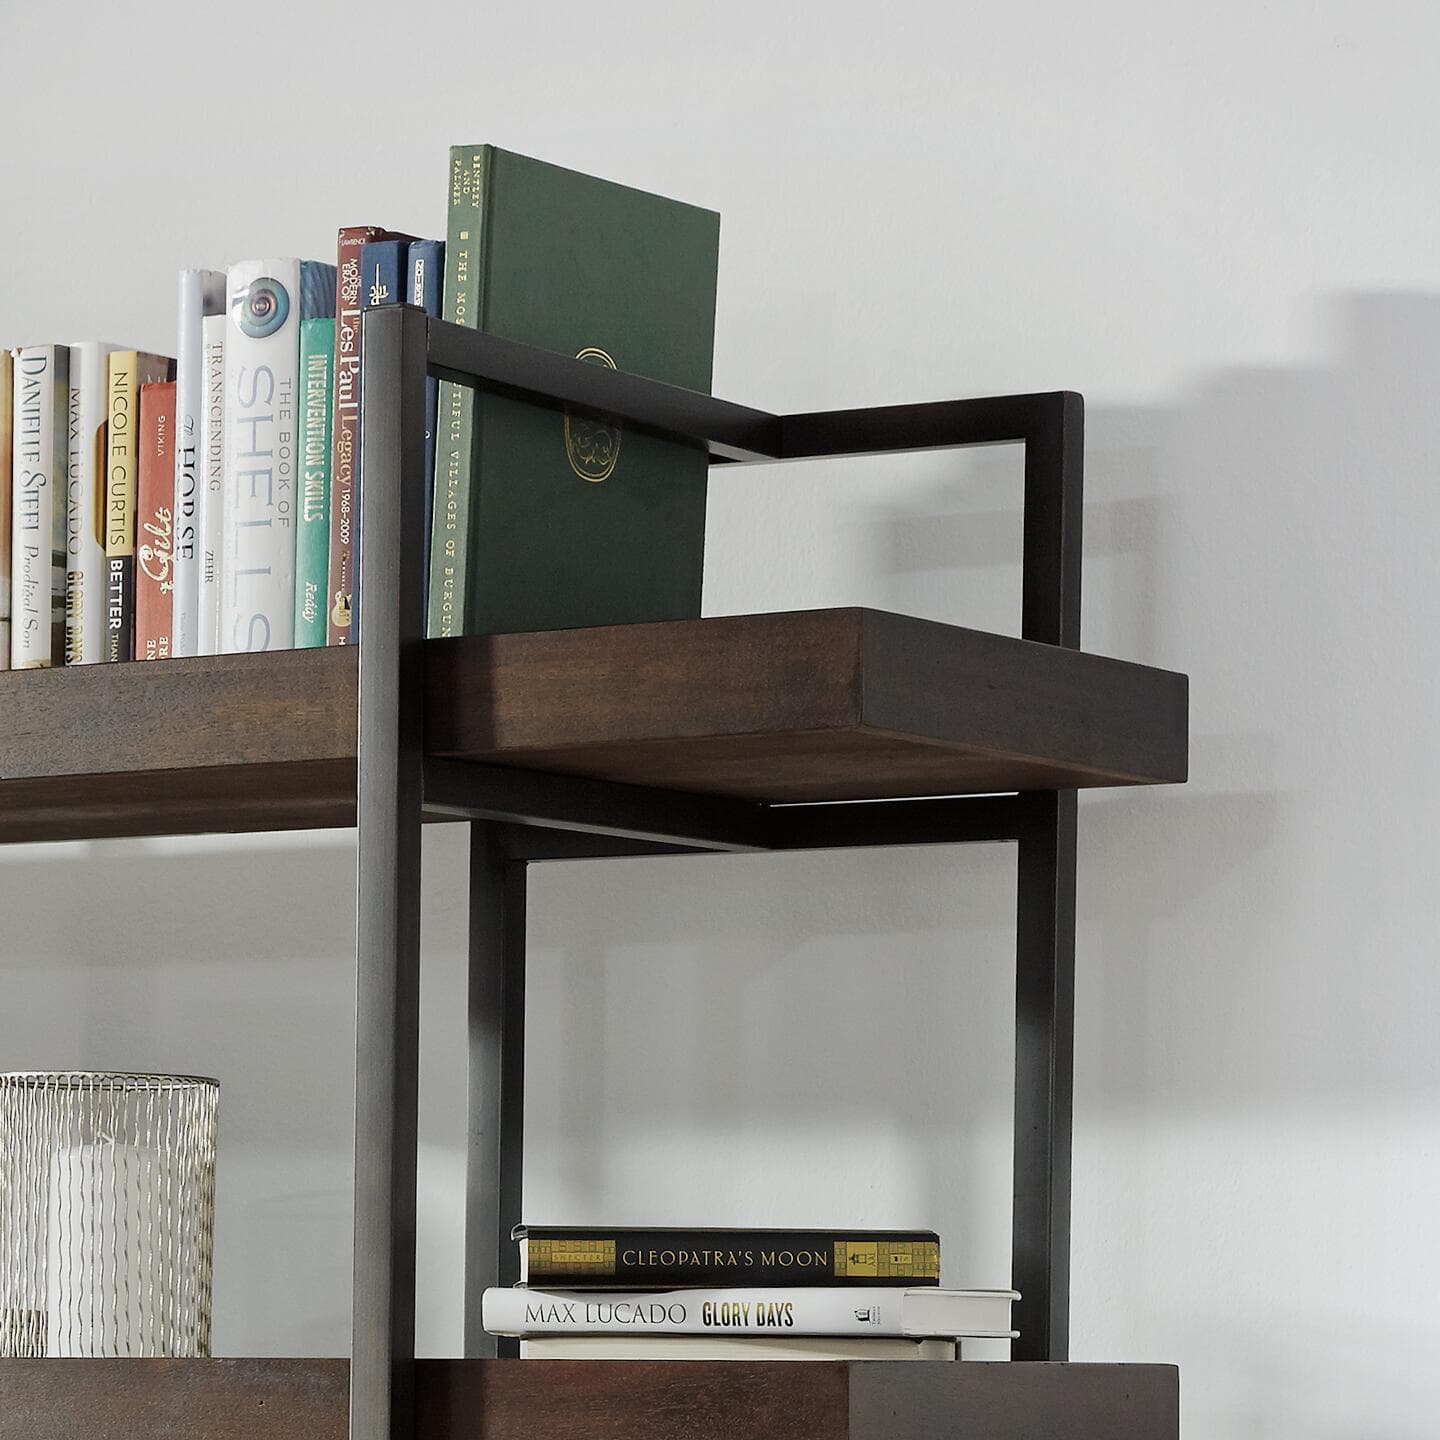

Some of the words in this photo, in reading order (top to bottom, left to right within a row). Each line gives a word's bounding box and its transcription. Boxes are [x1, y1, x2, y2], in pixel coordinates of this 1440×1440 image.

[453, 159, 462, 206] PALMER
[462, 169, 471, 195] AND
[471, 154, 481, 208] BENTLEY
[342, 263, 350, 284] ERA
[348, 258, 359, 306] MODERN
[457, 250, 468, 282] THE
[341, 286, 350, 301] OF
[455, 292, 466, 326] MOS
[339, 308, 360, 353] Les
[279, 378, 292, 419] THE
[338, 356, 359, 410] Paul
[19, 355, 47, 463] DANIELLE
[70, 387, 82, 441] MAX
[111, 371, 128, 456] NICOLE
[210, 341, 224, 492] TRANSCENDING
[305, 353, 327, 469] INTERVENTION
[157, 415, 166, 457] VIKING
[335, 414, 358, 485] Legacy
[278, 433, 291, 491] BOOK
[18, 470, 47, 532] STEEL
[68, 451, 82, 556] LUCADO
[110, 465, 127, 546] CURTIS
[232, 364, 275, 652] SHELLS
[303, 471, 324, 522] SKILLS
[446, 450, 460, 530] VILLAGES
[277, 501, 290, 529] OF
[139, 506, 174, 582] Gilt
[204, 550, 215, 583] ZEHR
[445, 539, 456, 557] OF
[66, 570, 84, 620] GLORY
[110, 559, 124, 630] BETTER
[301, 582, 317, 623] Reddy
[65, 624, 83, 664] DAYS
[110, 633, 119, 662] THAN
[622, 1250, 754, 1267] CLEOPATRA'S
[761, 1250, 828, 1267] MOON
[525, 1303, 576, 1324] MAX
[585, 1303, 687, 1324] LUCADO
[702, 1301, 751, 1327] GLORY
[756, 1302, 794, 1327] DAYS
